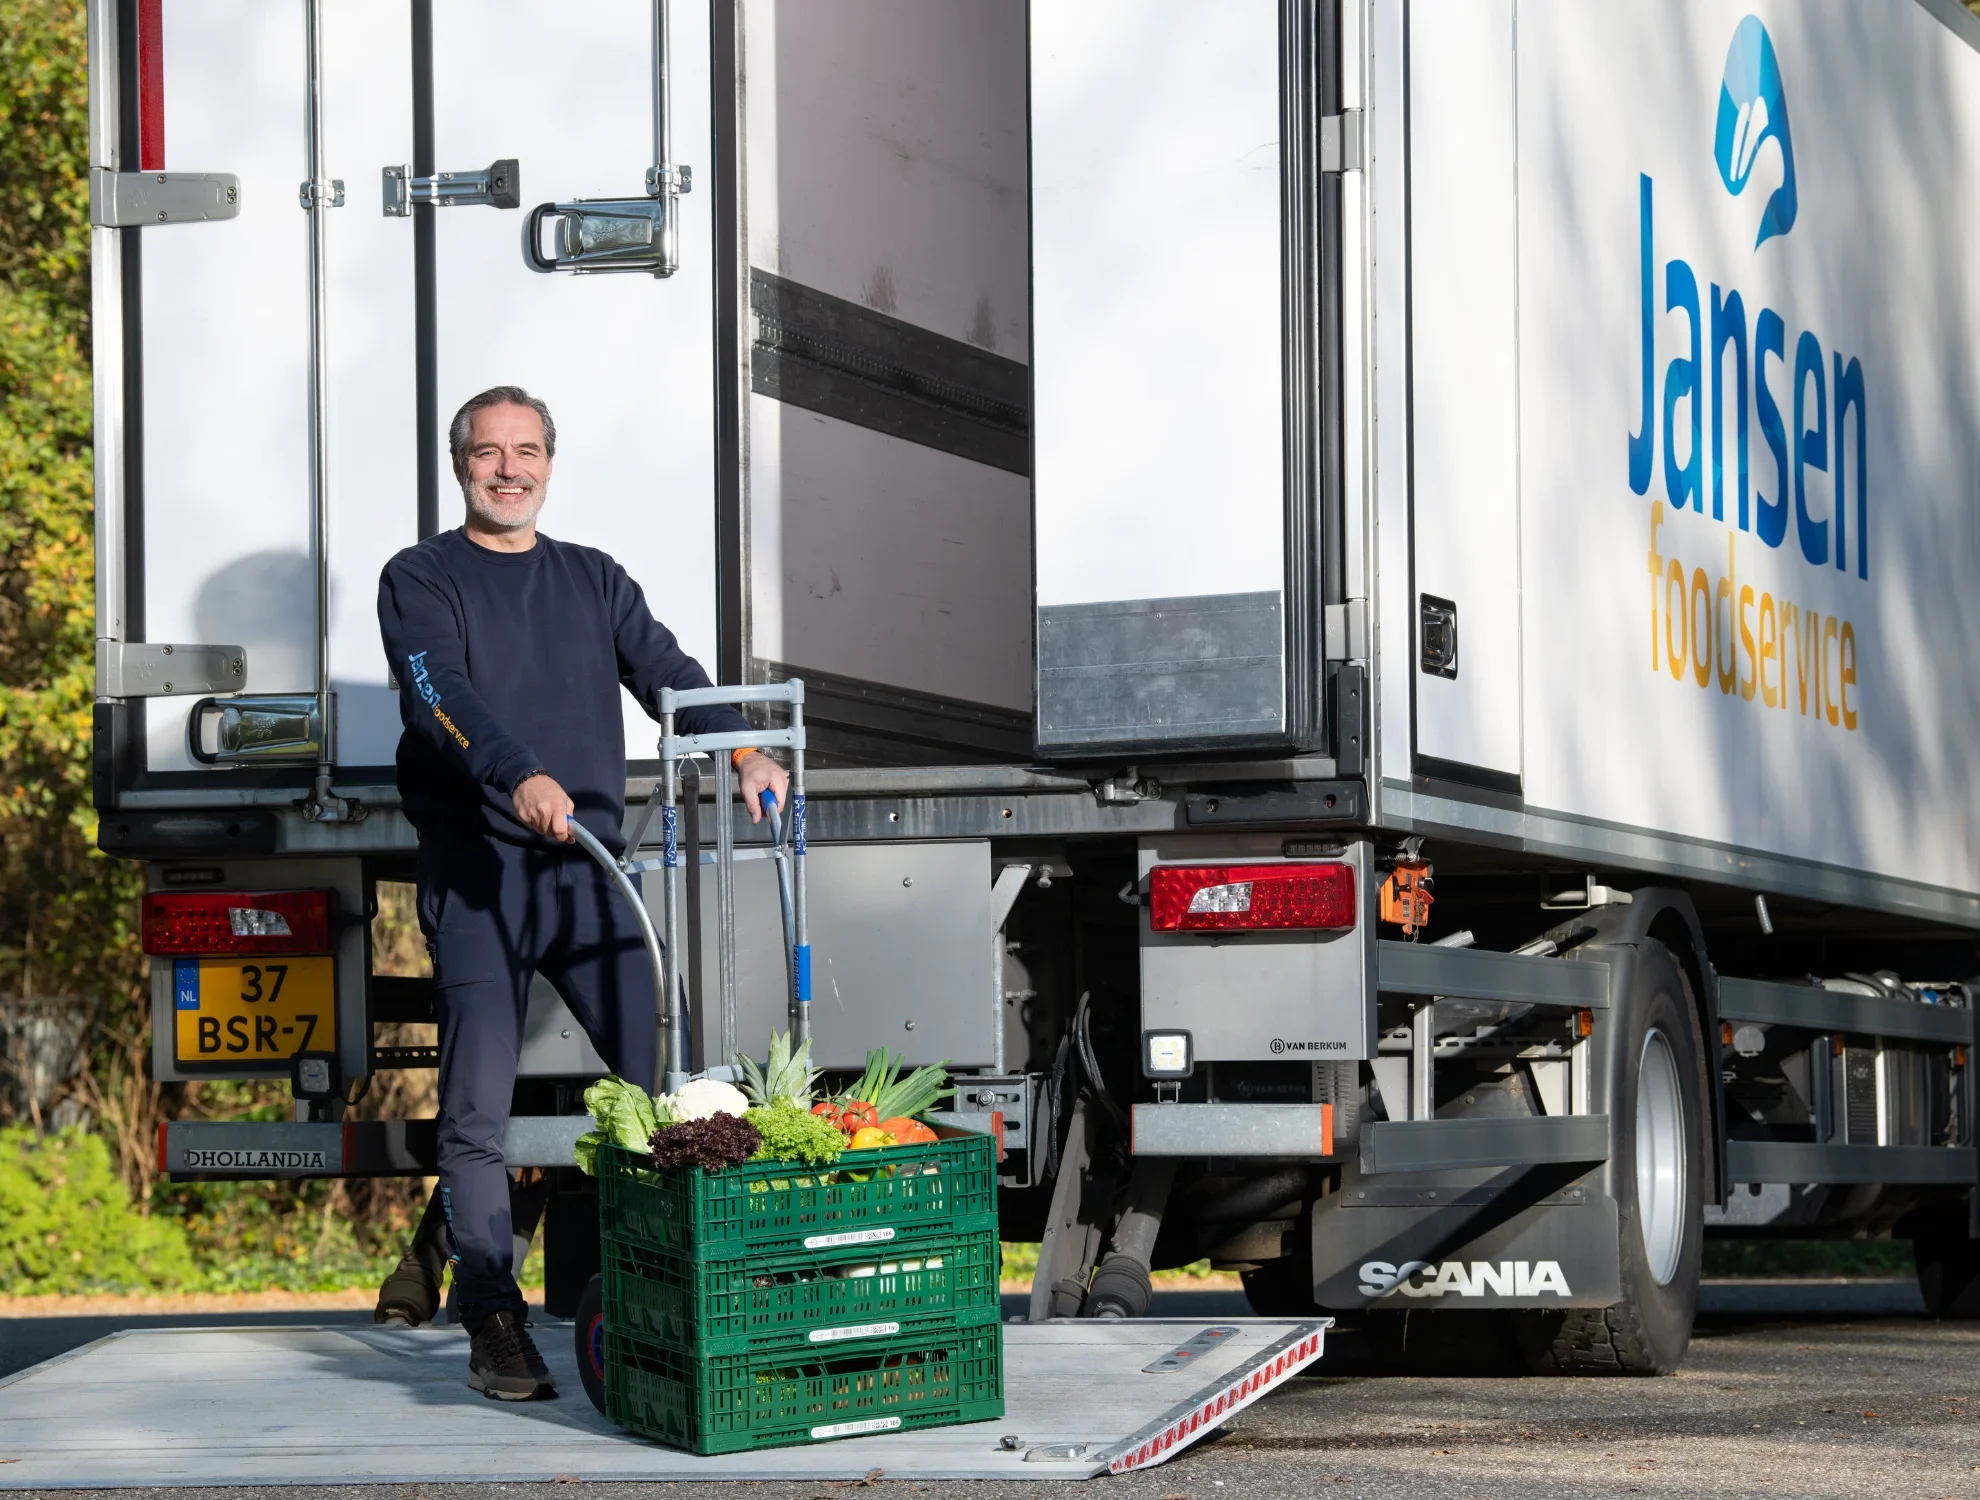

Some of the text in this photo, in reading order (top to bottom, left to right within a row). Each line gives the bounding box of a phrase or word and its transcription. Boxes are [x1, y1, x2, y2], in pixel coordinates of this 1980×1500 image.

[1628, 171, 1868, 582] Jansen
[1648, 499, 1858, 731] foodservice
[432, 703, 470, 750] foodservice
[181, 991, 197, 1002] NL
[241, 965, 288, 1003] 37
[198, 1014, 319, 1054] BSR-7
[1286, 1042, 1305, 1050] VAN
[1307, 1041, 1347, 1050] BERKUM
[189, 1151, 325, 1168] DHOLLANDIA
[1358, 1260, 1573, 1298] SCANIA
